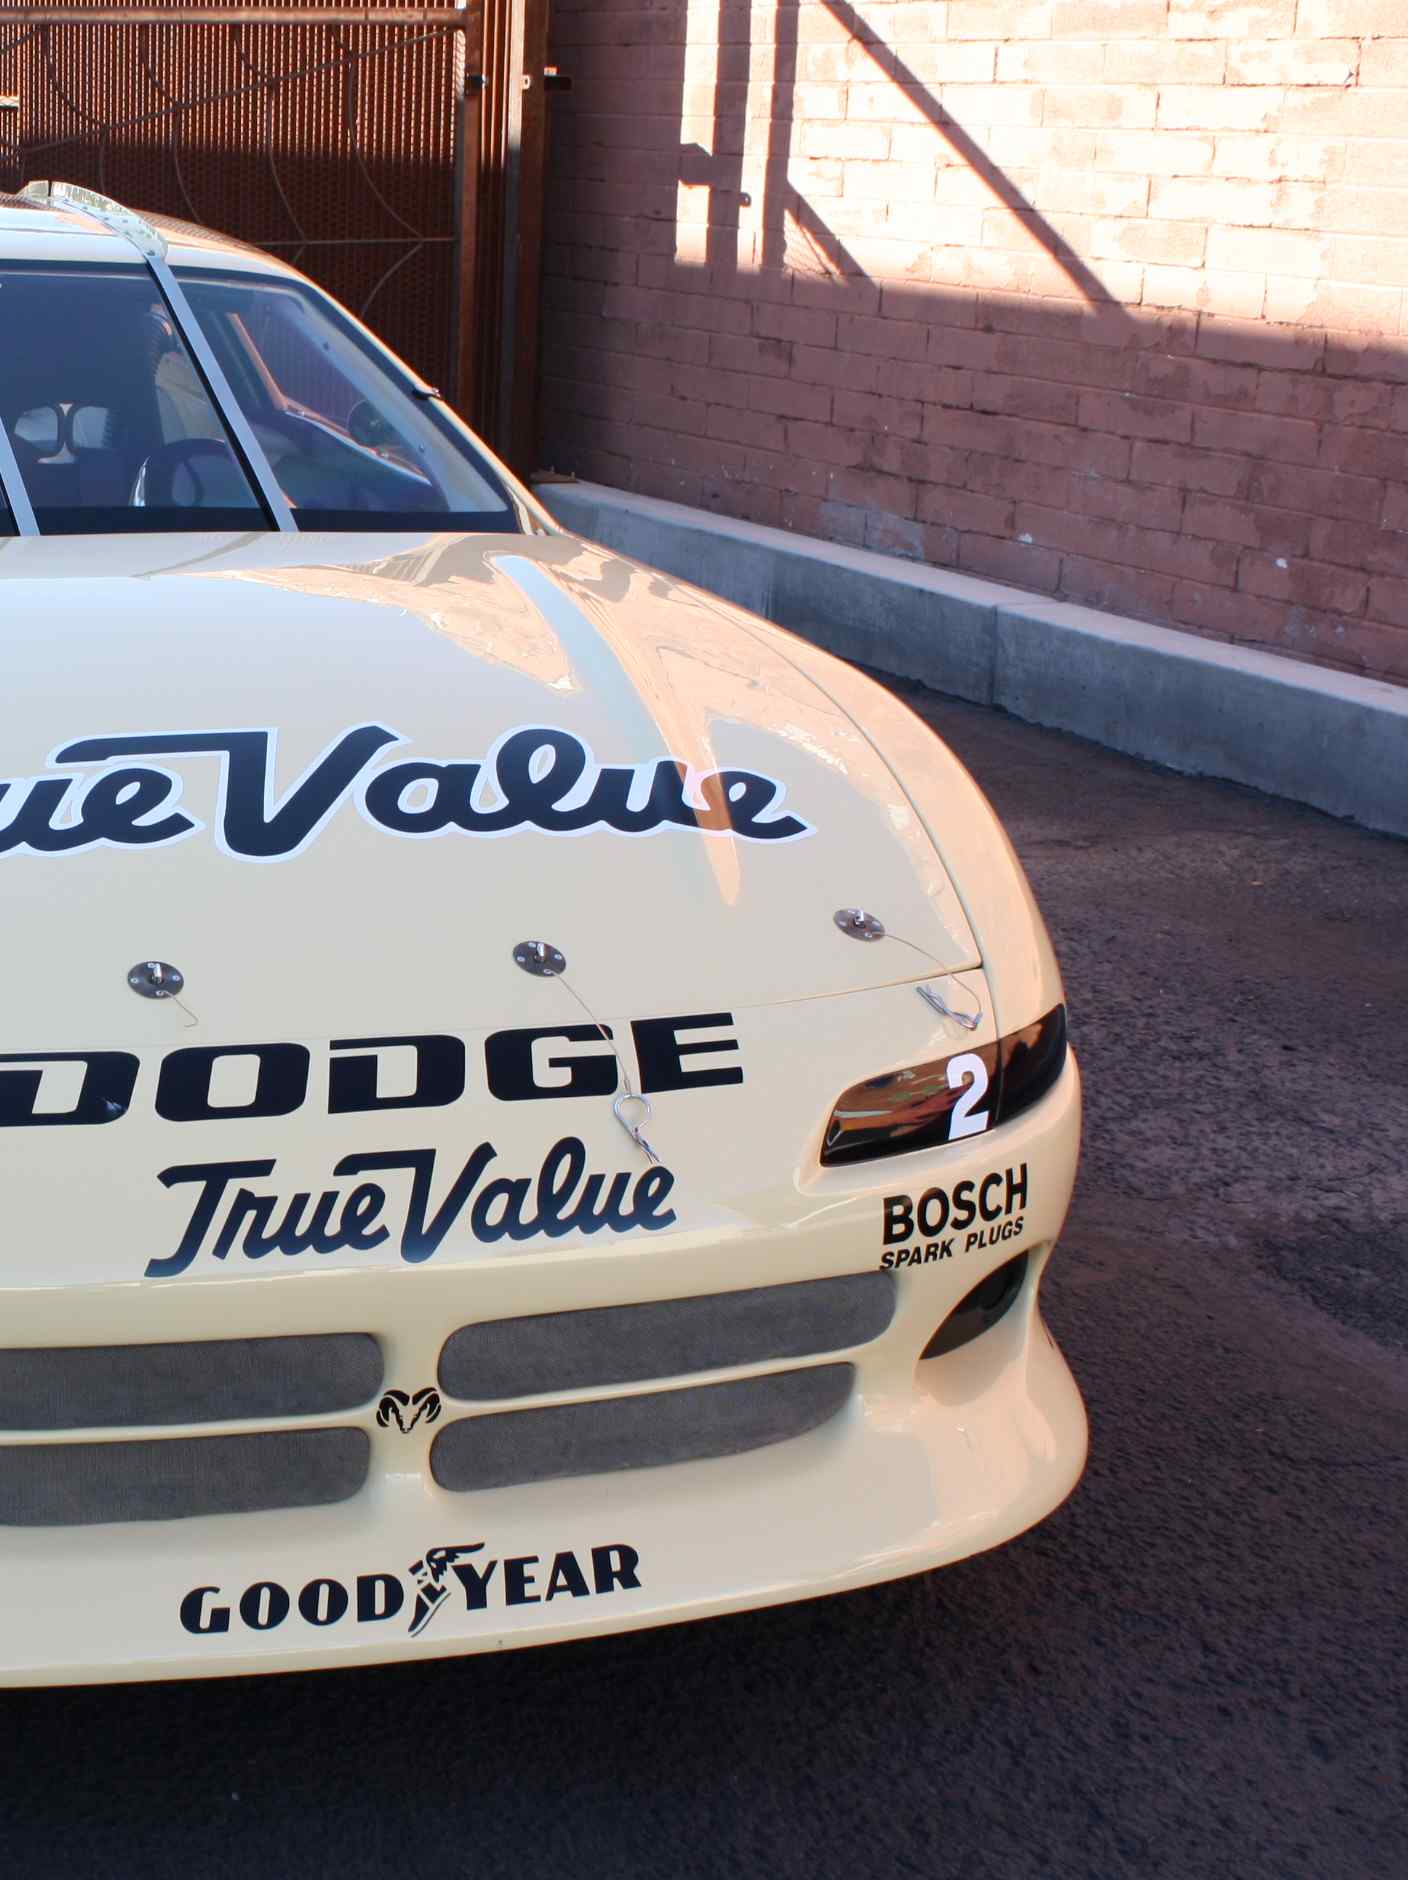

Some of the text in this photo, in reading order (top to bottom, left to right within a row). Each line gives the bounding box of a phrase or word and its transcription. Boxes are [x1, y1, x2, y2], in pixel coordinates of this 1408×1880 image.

[945, 1053, 991, 1141] 2
[880, 1216, 1025, 1272] SPARK PLUGS
[882, 1163, 1028, 1245] BOSCH
